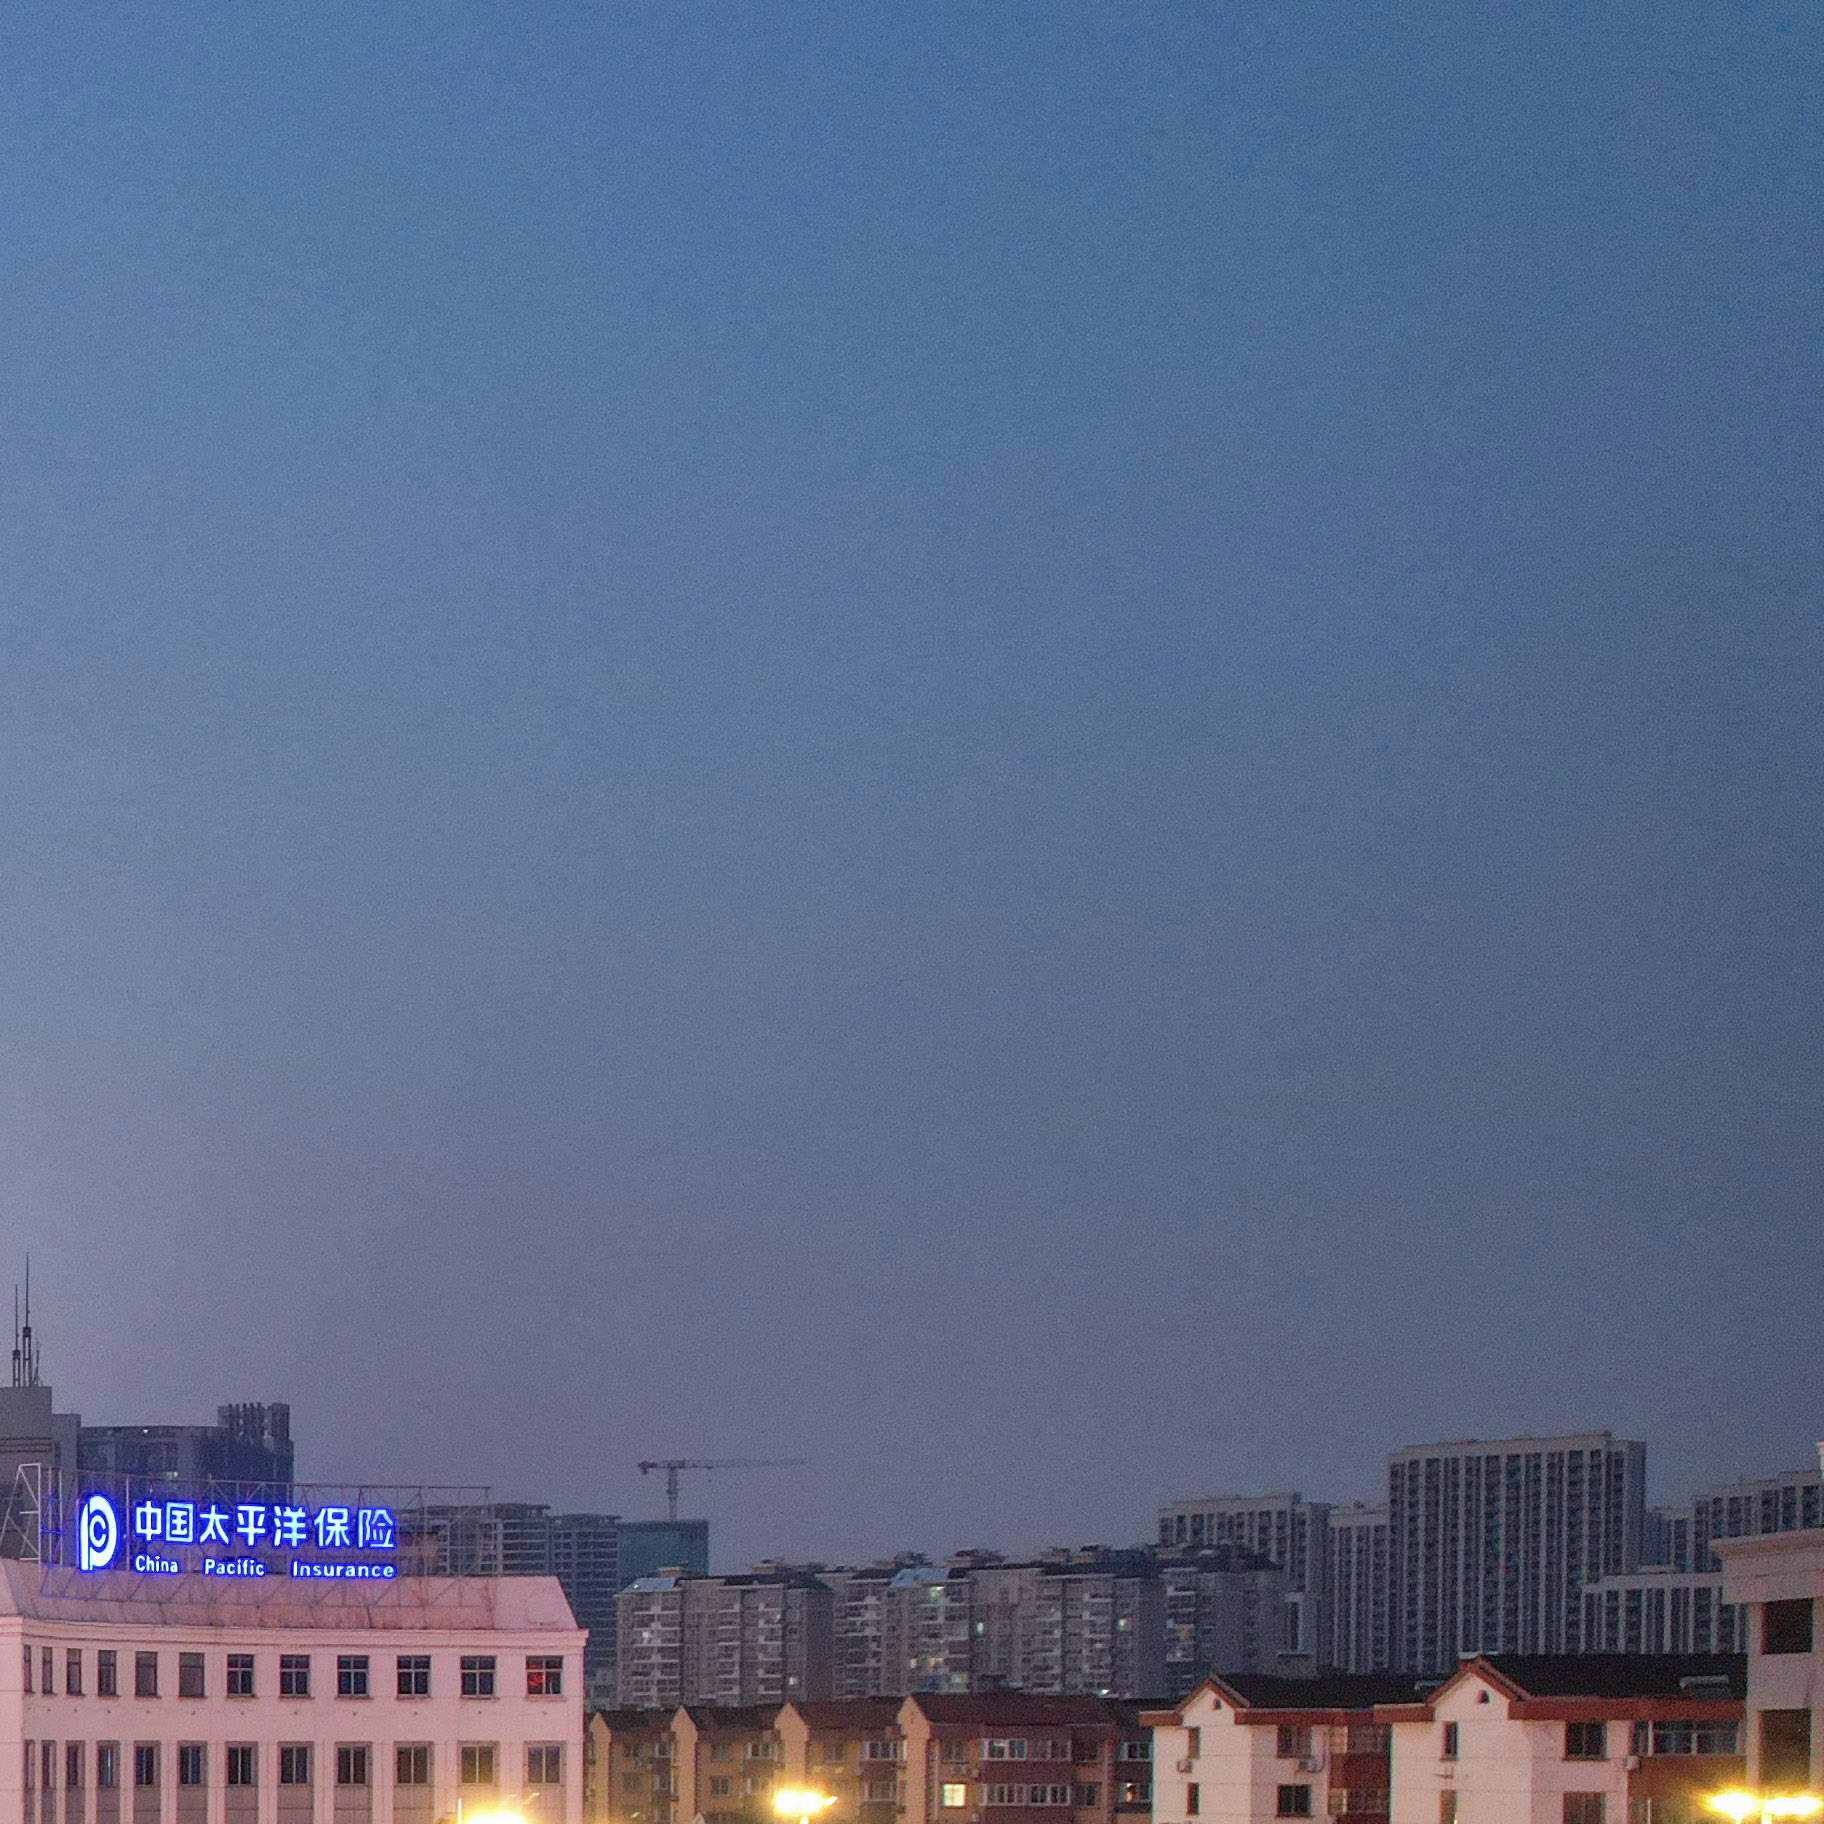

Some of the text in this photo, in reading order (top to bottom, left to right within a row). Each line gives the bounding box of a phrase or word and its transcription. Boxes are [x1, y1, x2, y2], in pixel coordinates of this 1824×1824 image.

[134, 1499, 396, 1549] 中国太平洋保险
[134, 1554, 395, 1579] China Pacific Insurance
